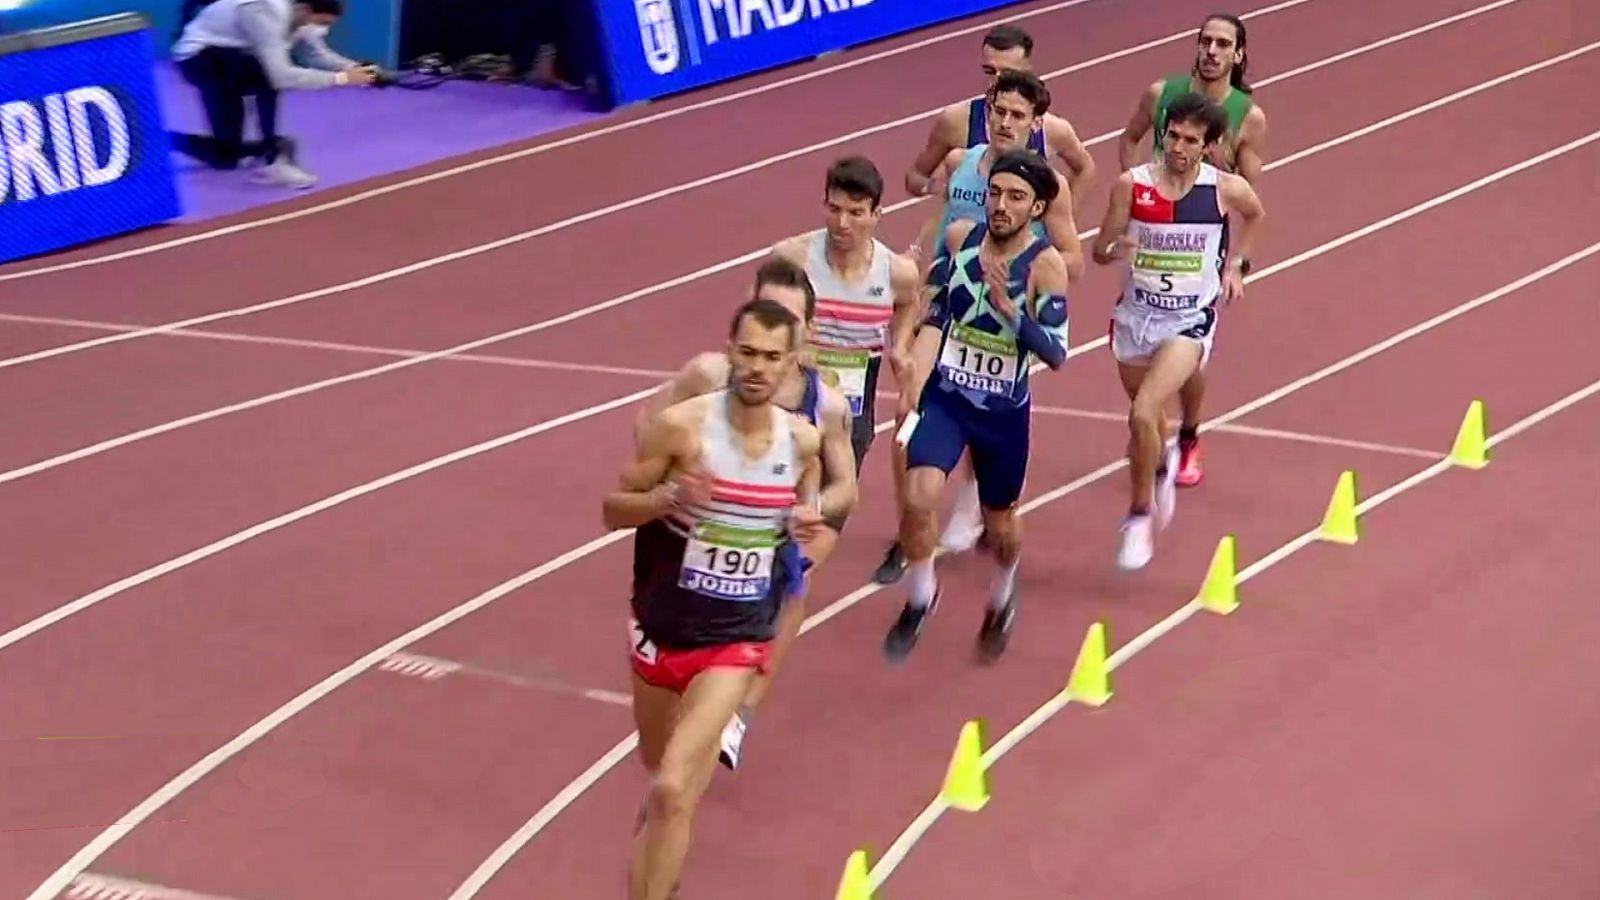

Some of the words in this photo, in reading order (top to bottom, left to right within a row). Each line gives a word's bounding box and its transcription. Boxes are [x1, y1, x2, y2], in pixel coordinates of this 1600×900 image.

[699, 0, 876, 45] MAD
[0, 86, 131, 206] RID
[1159, 273, 1173, 292] 5
[958, 346, 1004, 375] 110
[704, 547, 760, 575] 190
